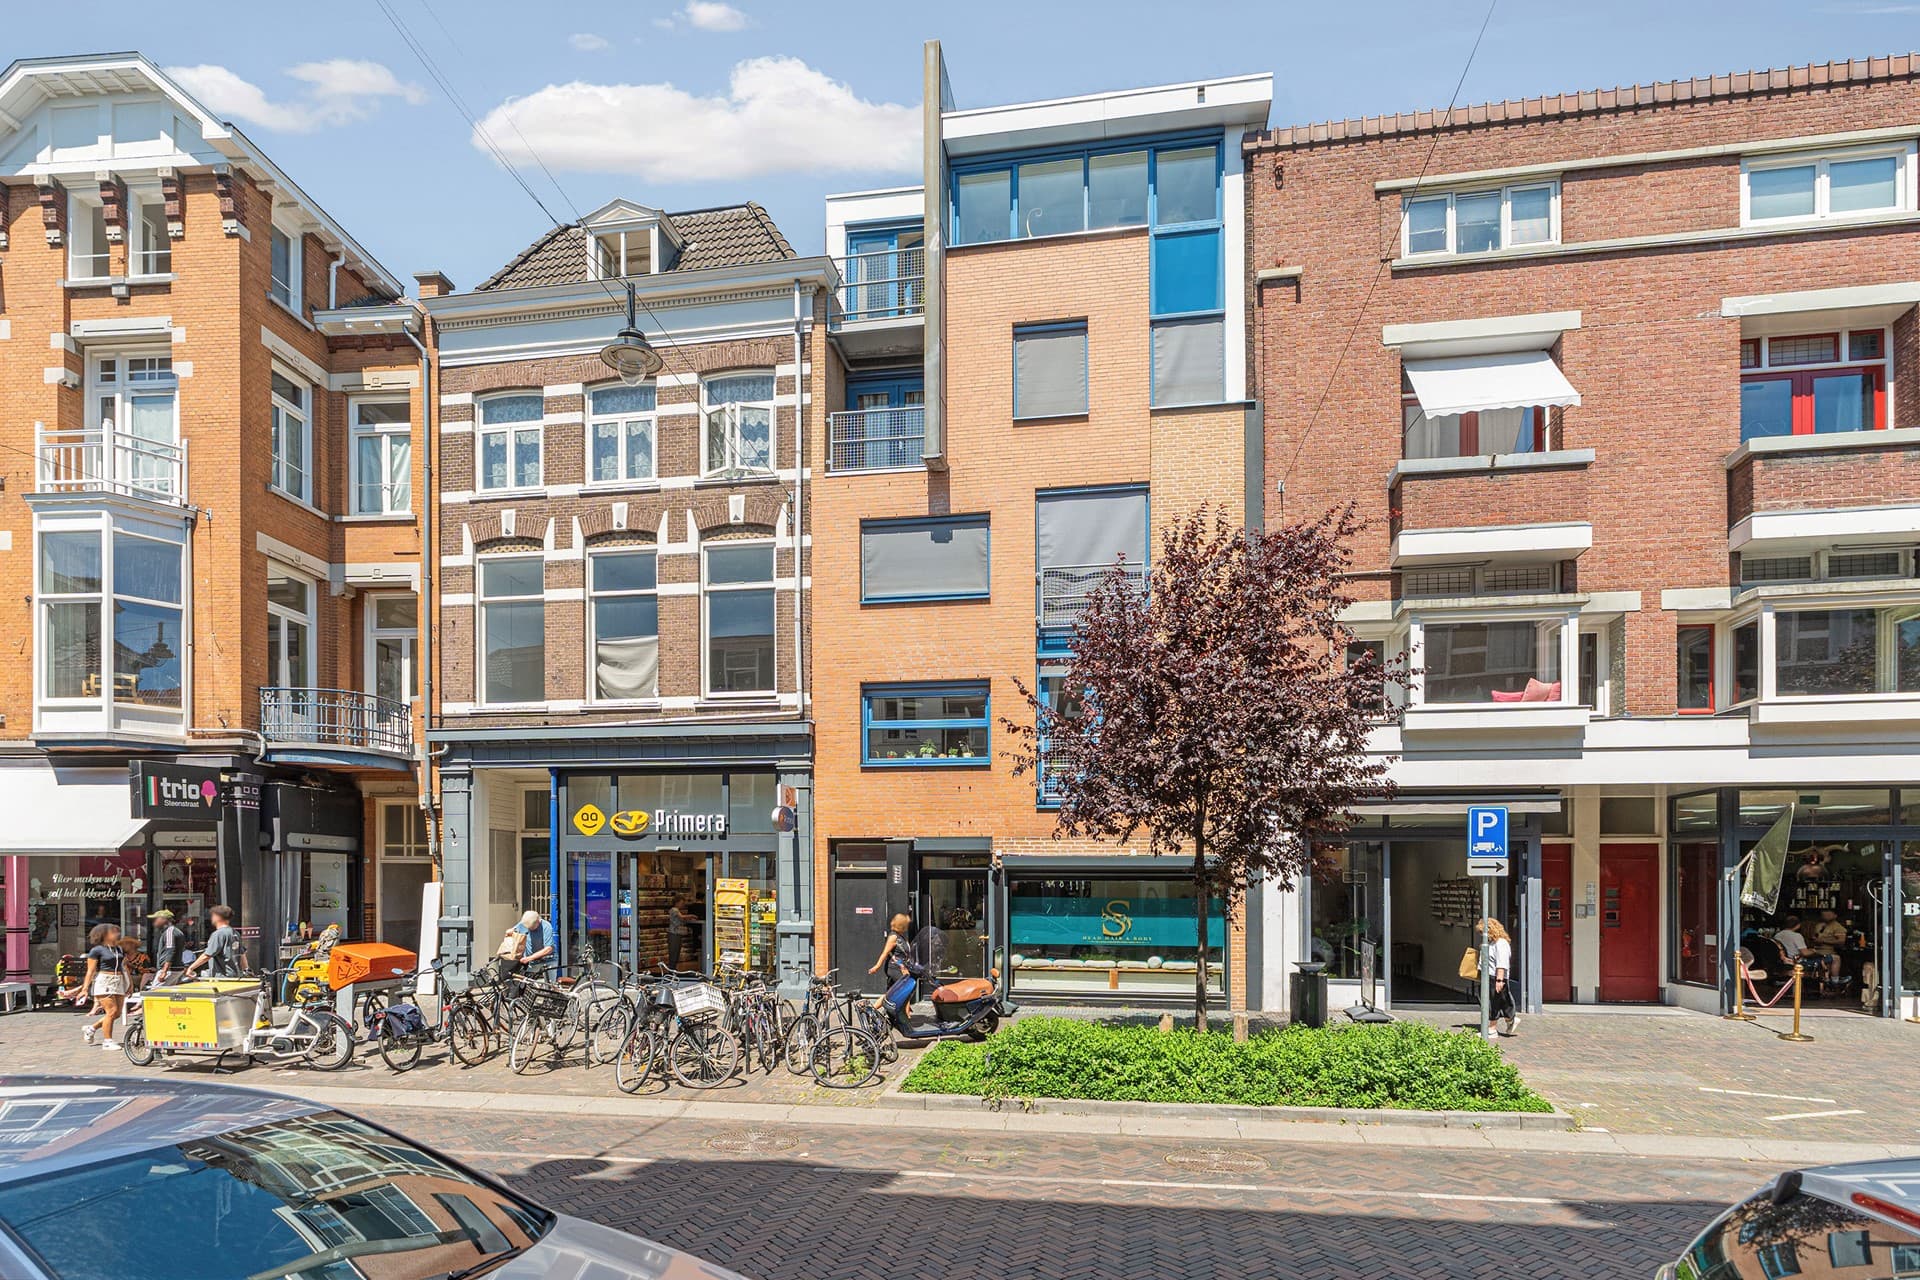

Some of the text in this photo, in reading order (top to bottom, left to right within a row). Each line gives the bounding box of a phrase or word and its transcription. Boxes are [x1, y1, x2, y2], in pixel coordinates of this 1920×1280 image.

[160, 777, 200, 799] trio
[655, 809, 725, 832] Primera
[1478, 812, 1498, 837] P
